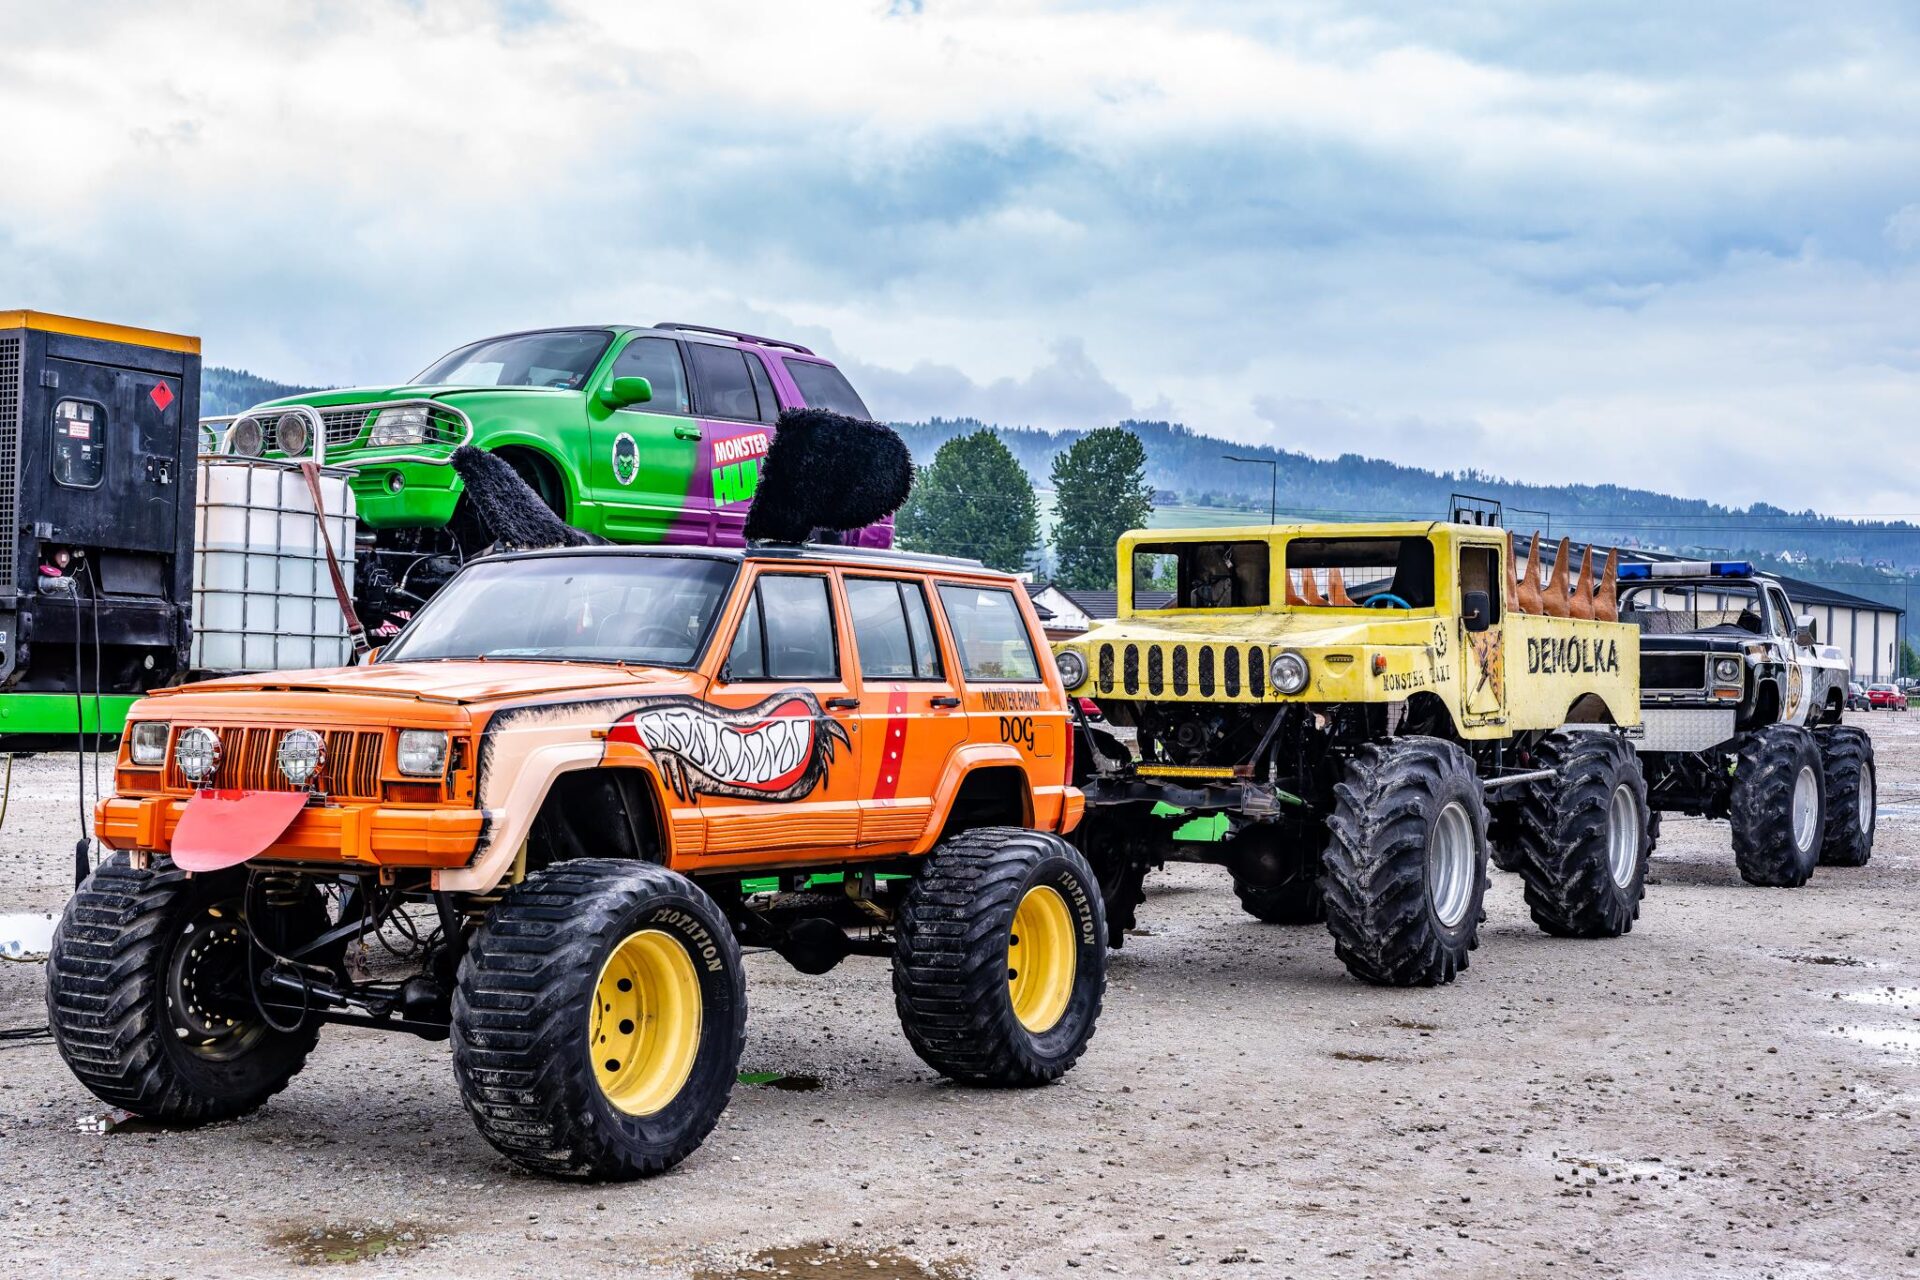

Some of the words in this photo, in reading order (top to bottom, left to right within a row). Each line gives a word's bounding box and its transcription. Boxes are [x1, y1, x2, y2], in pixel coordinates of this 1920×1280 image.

[714, 433, 768, 463] MONSTER
[712, 456, 766, 508] HUL
[1527, 635, 1619, 675] DEMOLKA
[1383, 670, 1425, 691] MONSTER
[1429, 665, 1450, 683] TAXI
[982, 688, 1018, 711] MONSTER
[999, 716, 1034, 751] DOG
[1057, 871, 1095, 945] FLOTATION
[649, 908, 723, 973] FLOTATION
